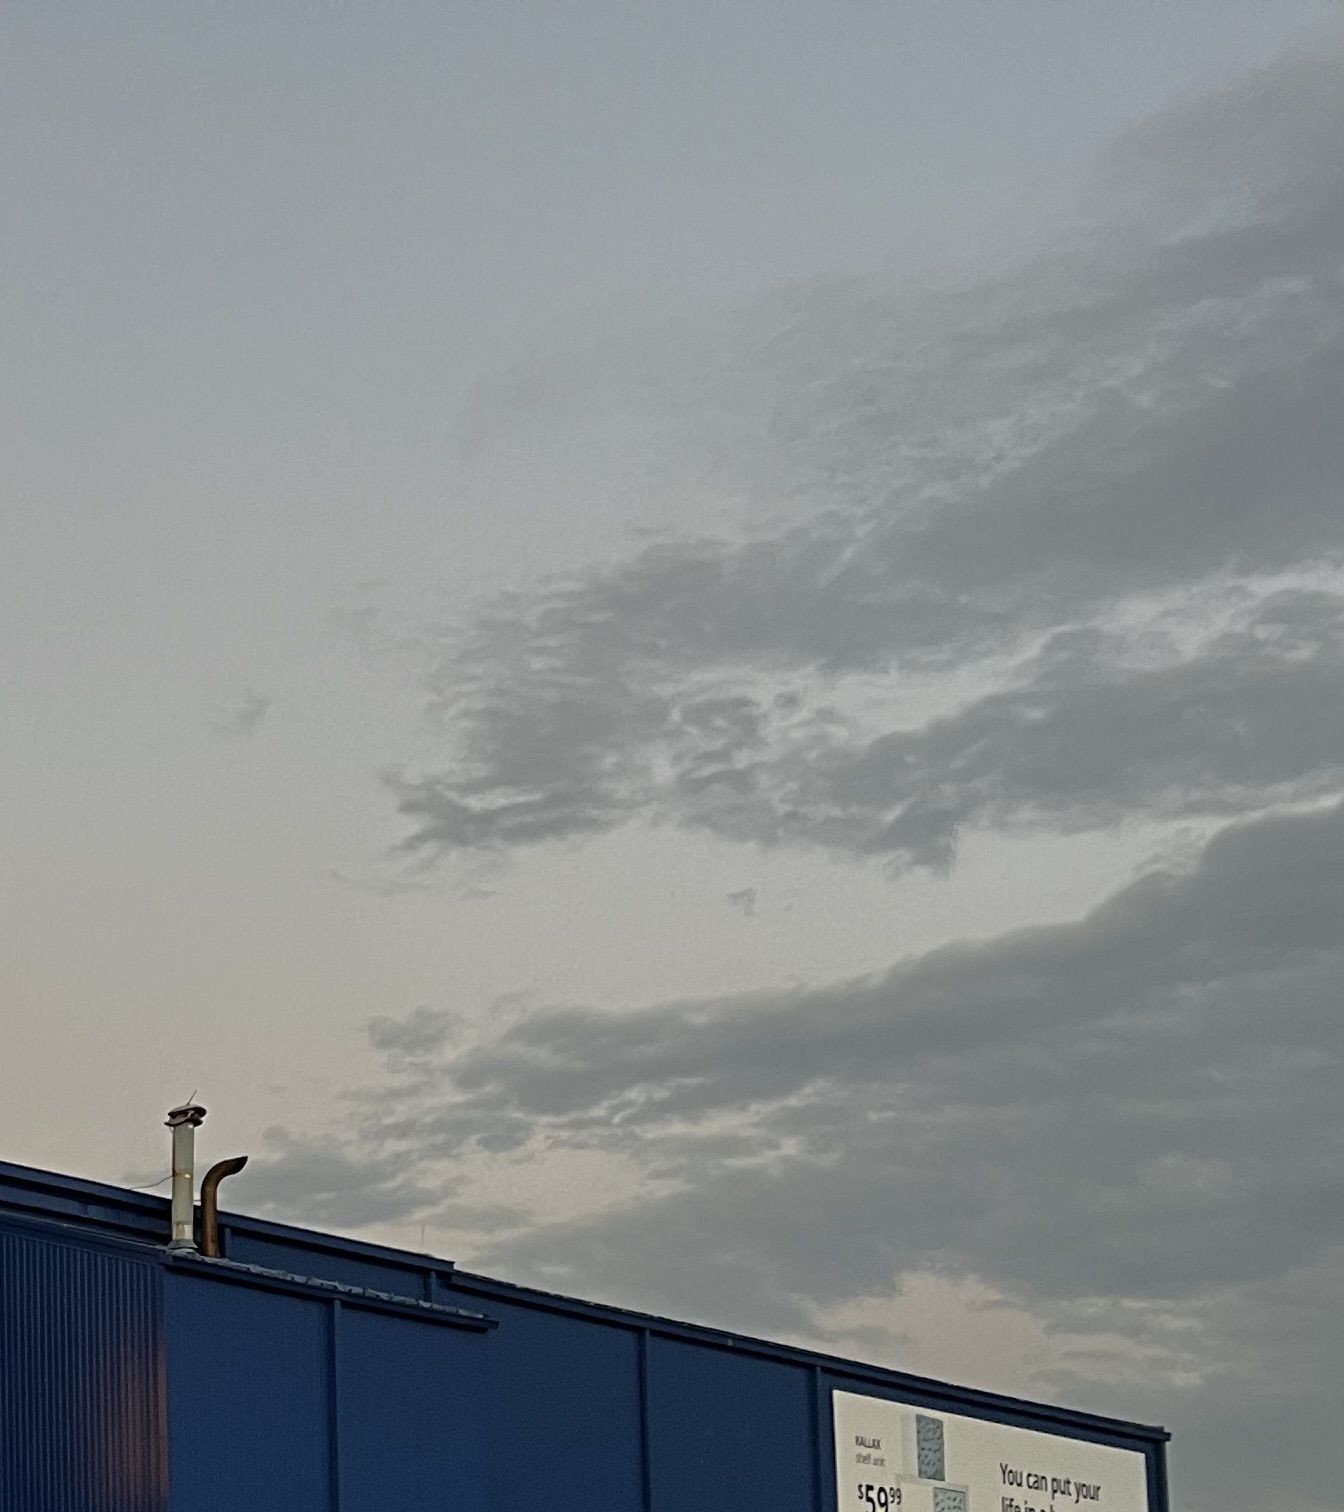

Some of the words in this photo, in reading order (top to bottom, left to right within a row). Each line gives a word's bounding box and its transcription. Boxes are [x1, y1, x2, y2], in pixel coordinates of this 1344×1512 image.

[1000, 1462, 1023, 1487] You
[1026, 1473, 1047, 1492] can
[1051, 1477, 1072, 1500] put
[1074, 1481, 1101, 1504] your
